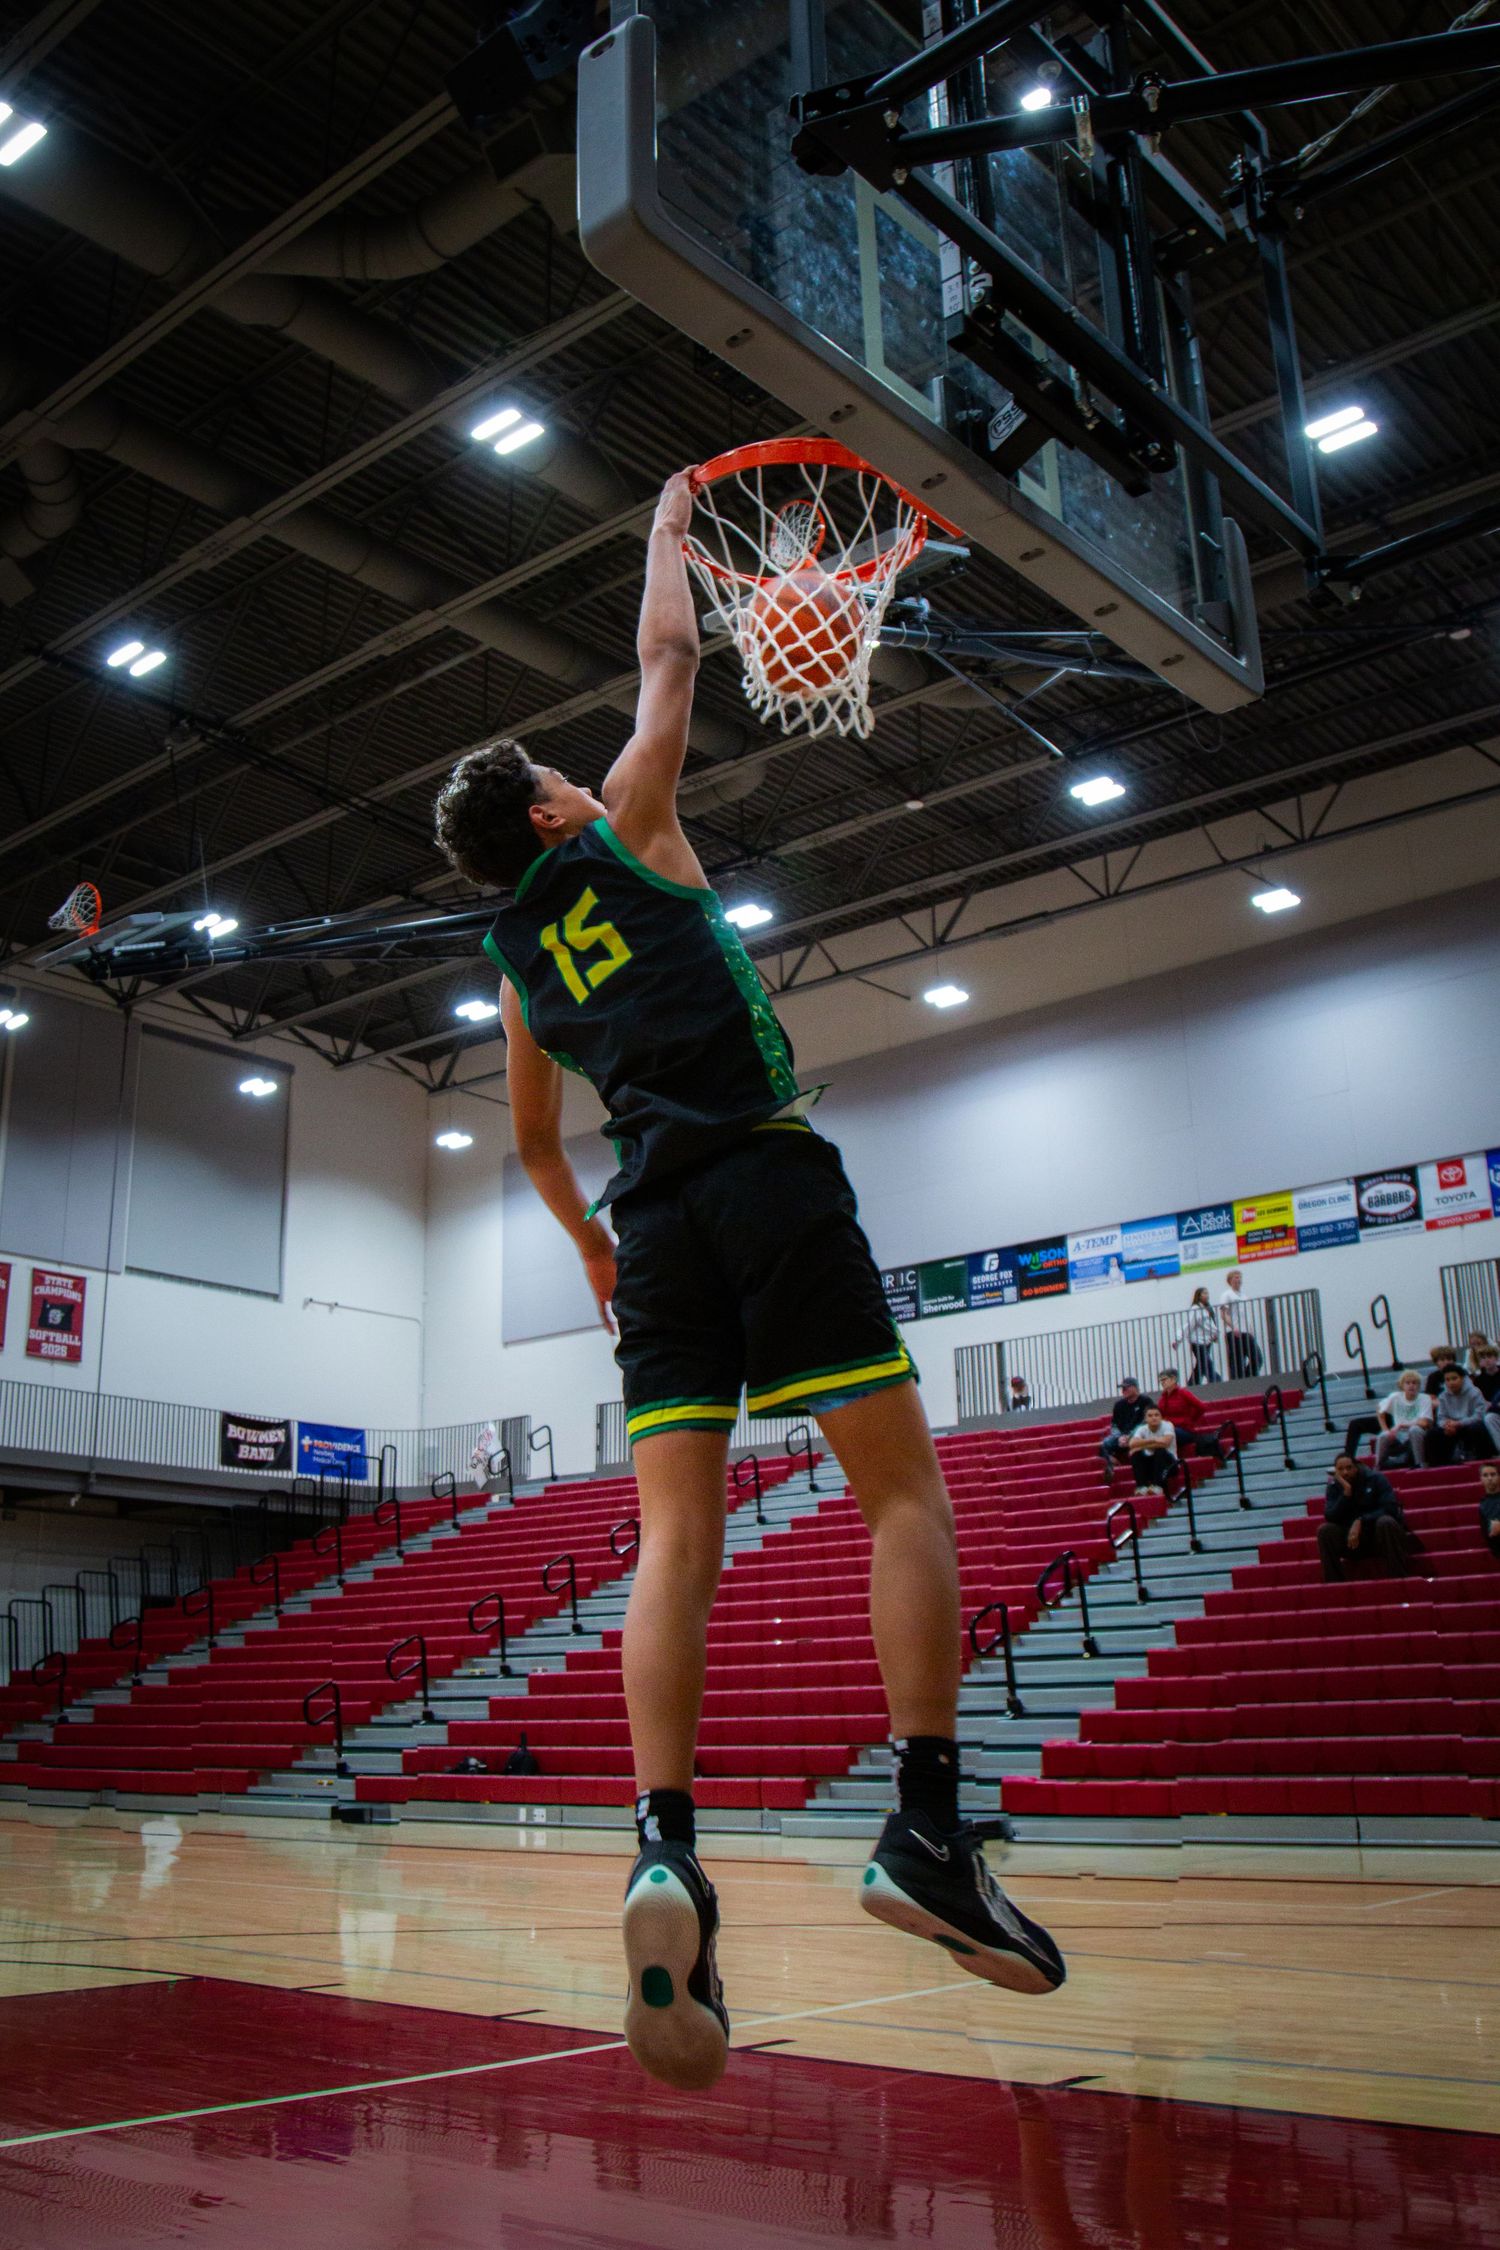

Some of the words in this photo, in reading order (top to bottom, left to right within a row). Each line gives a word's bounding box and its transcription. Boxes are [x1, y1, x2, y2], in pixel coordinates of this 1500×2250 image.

[540, 884, 632, 1006] 15
[1298, 1198, 1328, 1210] OREGON
[1328, 1193, 1352, 1205] CLINIC
[1435, 1191, 1477, 1205] TOYOTA
[1201, 1210, 1231, 1228] peak
[1074, 1234, 1118, 1252] A-TEMP
[1043, 1258, 1068, 1269] ORTHO
[44, 1275, 73, 1290] STATE
[972, 1272, 998, 1285] GEORGE
[999, 1270, 1013, 1281] FOX
[973, 1278, 1013, 1291] UNIVERSITY
[34, 1286, 82, 1303] CHAMPIONS
[1023, 1288, 1033, 1297] GO
[923, 1298, 967, 1314] Sherwood.
[29, 1329, 81, 1346] SOFTBALL
[227, 1423, 286, 1443] BOWMEN
[238, 1444, 274, 1461] BAND
[313, 1439, 361, 1453] PROVIDENCE
